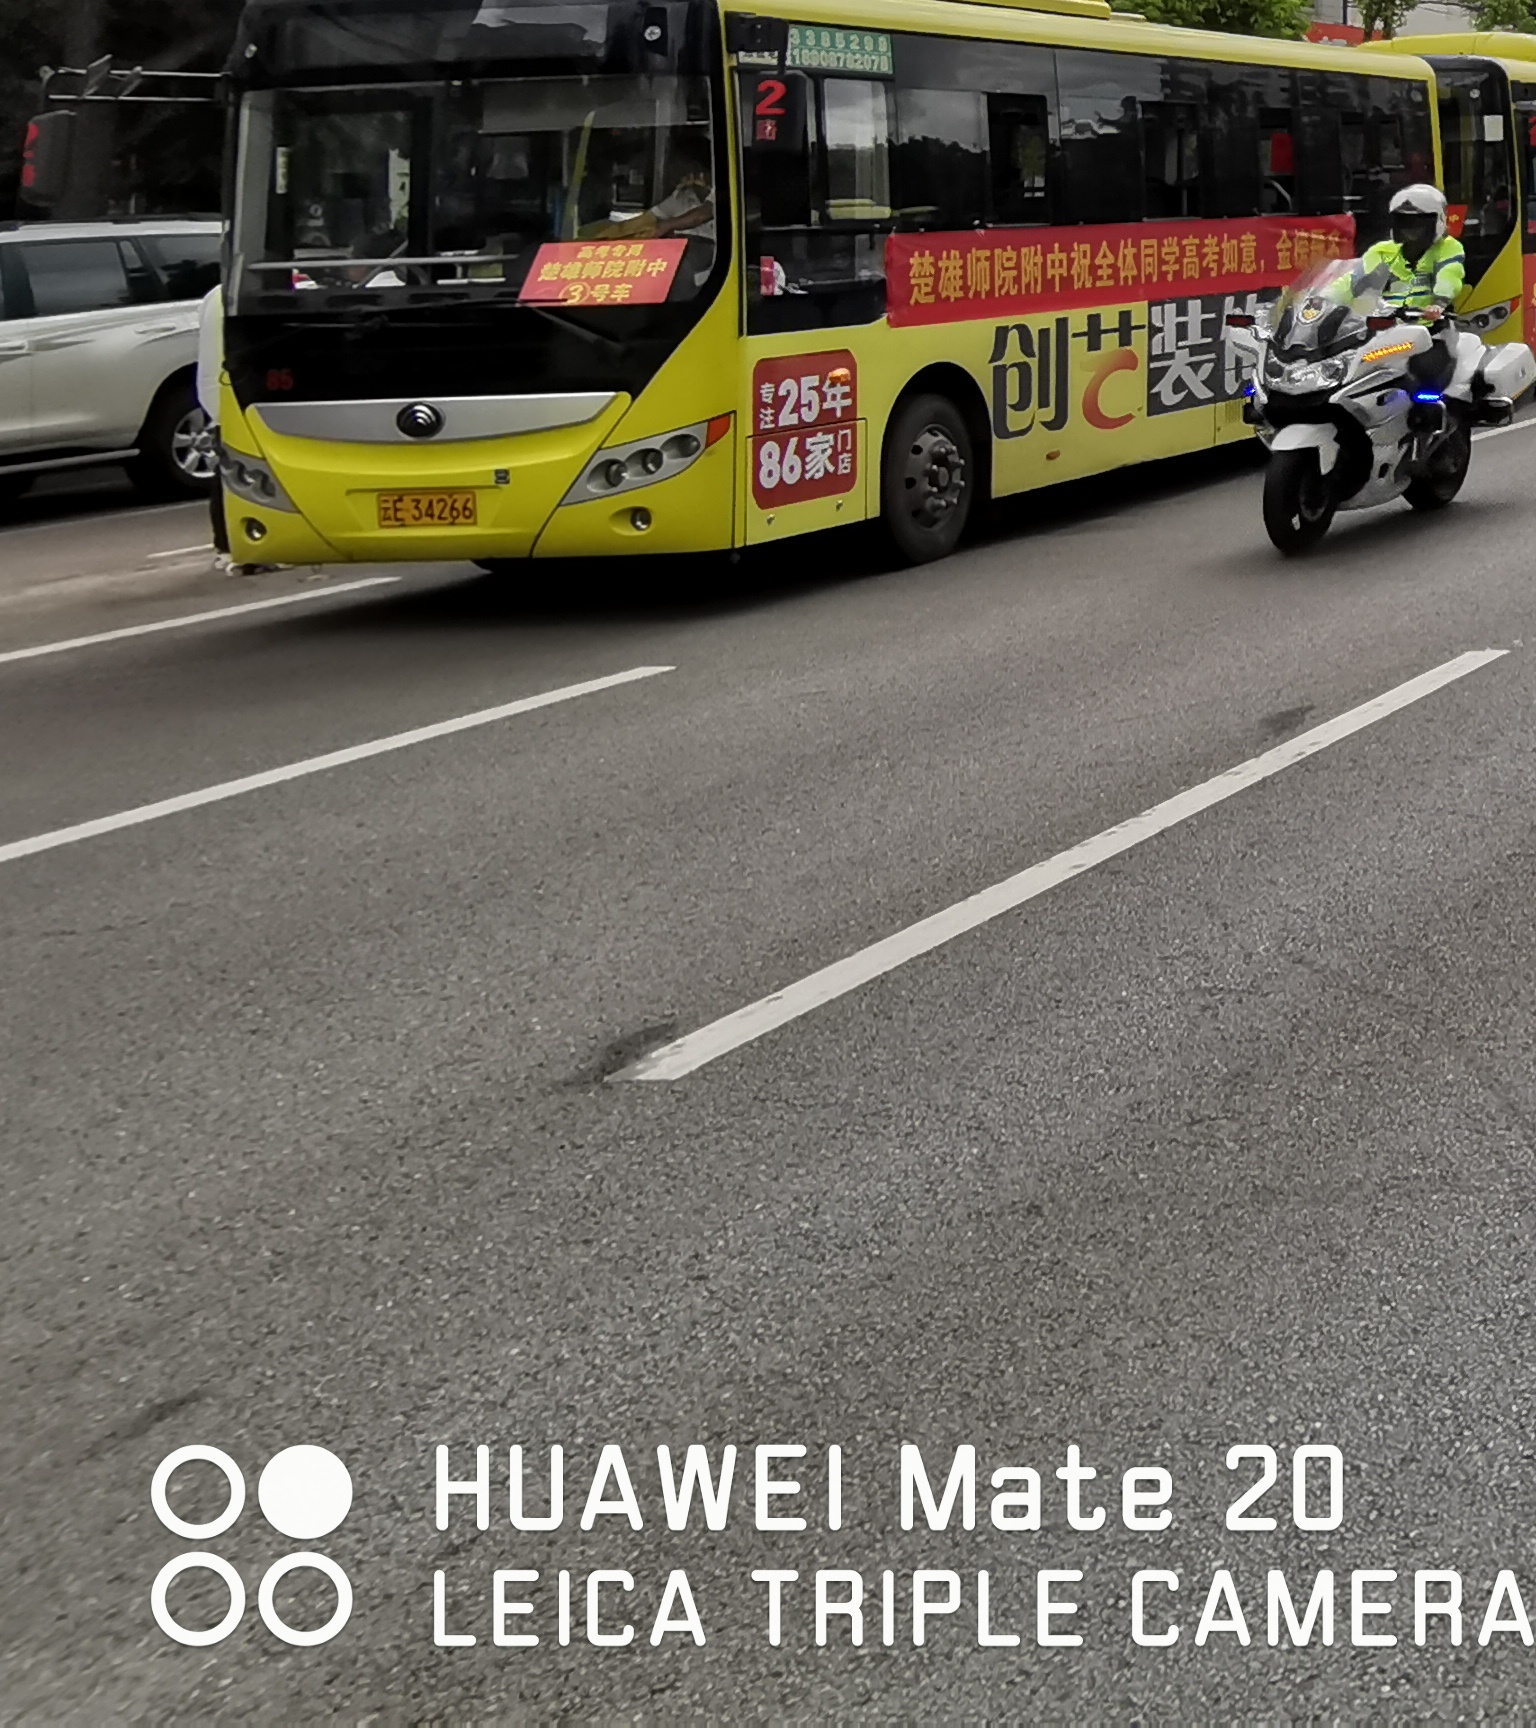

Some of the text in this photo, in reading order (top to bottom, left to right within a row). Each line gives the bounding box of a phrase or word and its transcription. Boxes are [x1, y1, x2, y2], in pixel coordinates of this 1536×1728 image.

[755, 79, 787, 115] 2
[537, 258, 668, 282] 楚雄师院附中
[758, 382, 775, 430] 专注
[777, 371, 853, 428] 25年
[759, 431, 836, 489] 86家
[837, 428, 853, 475] 门店
